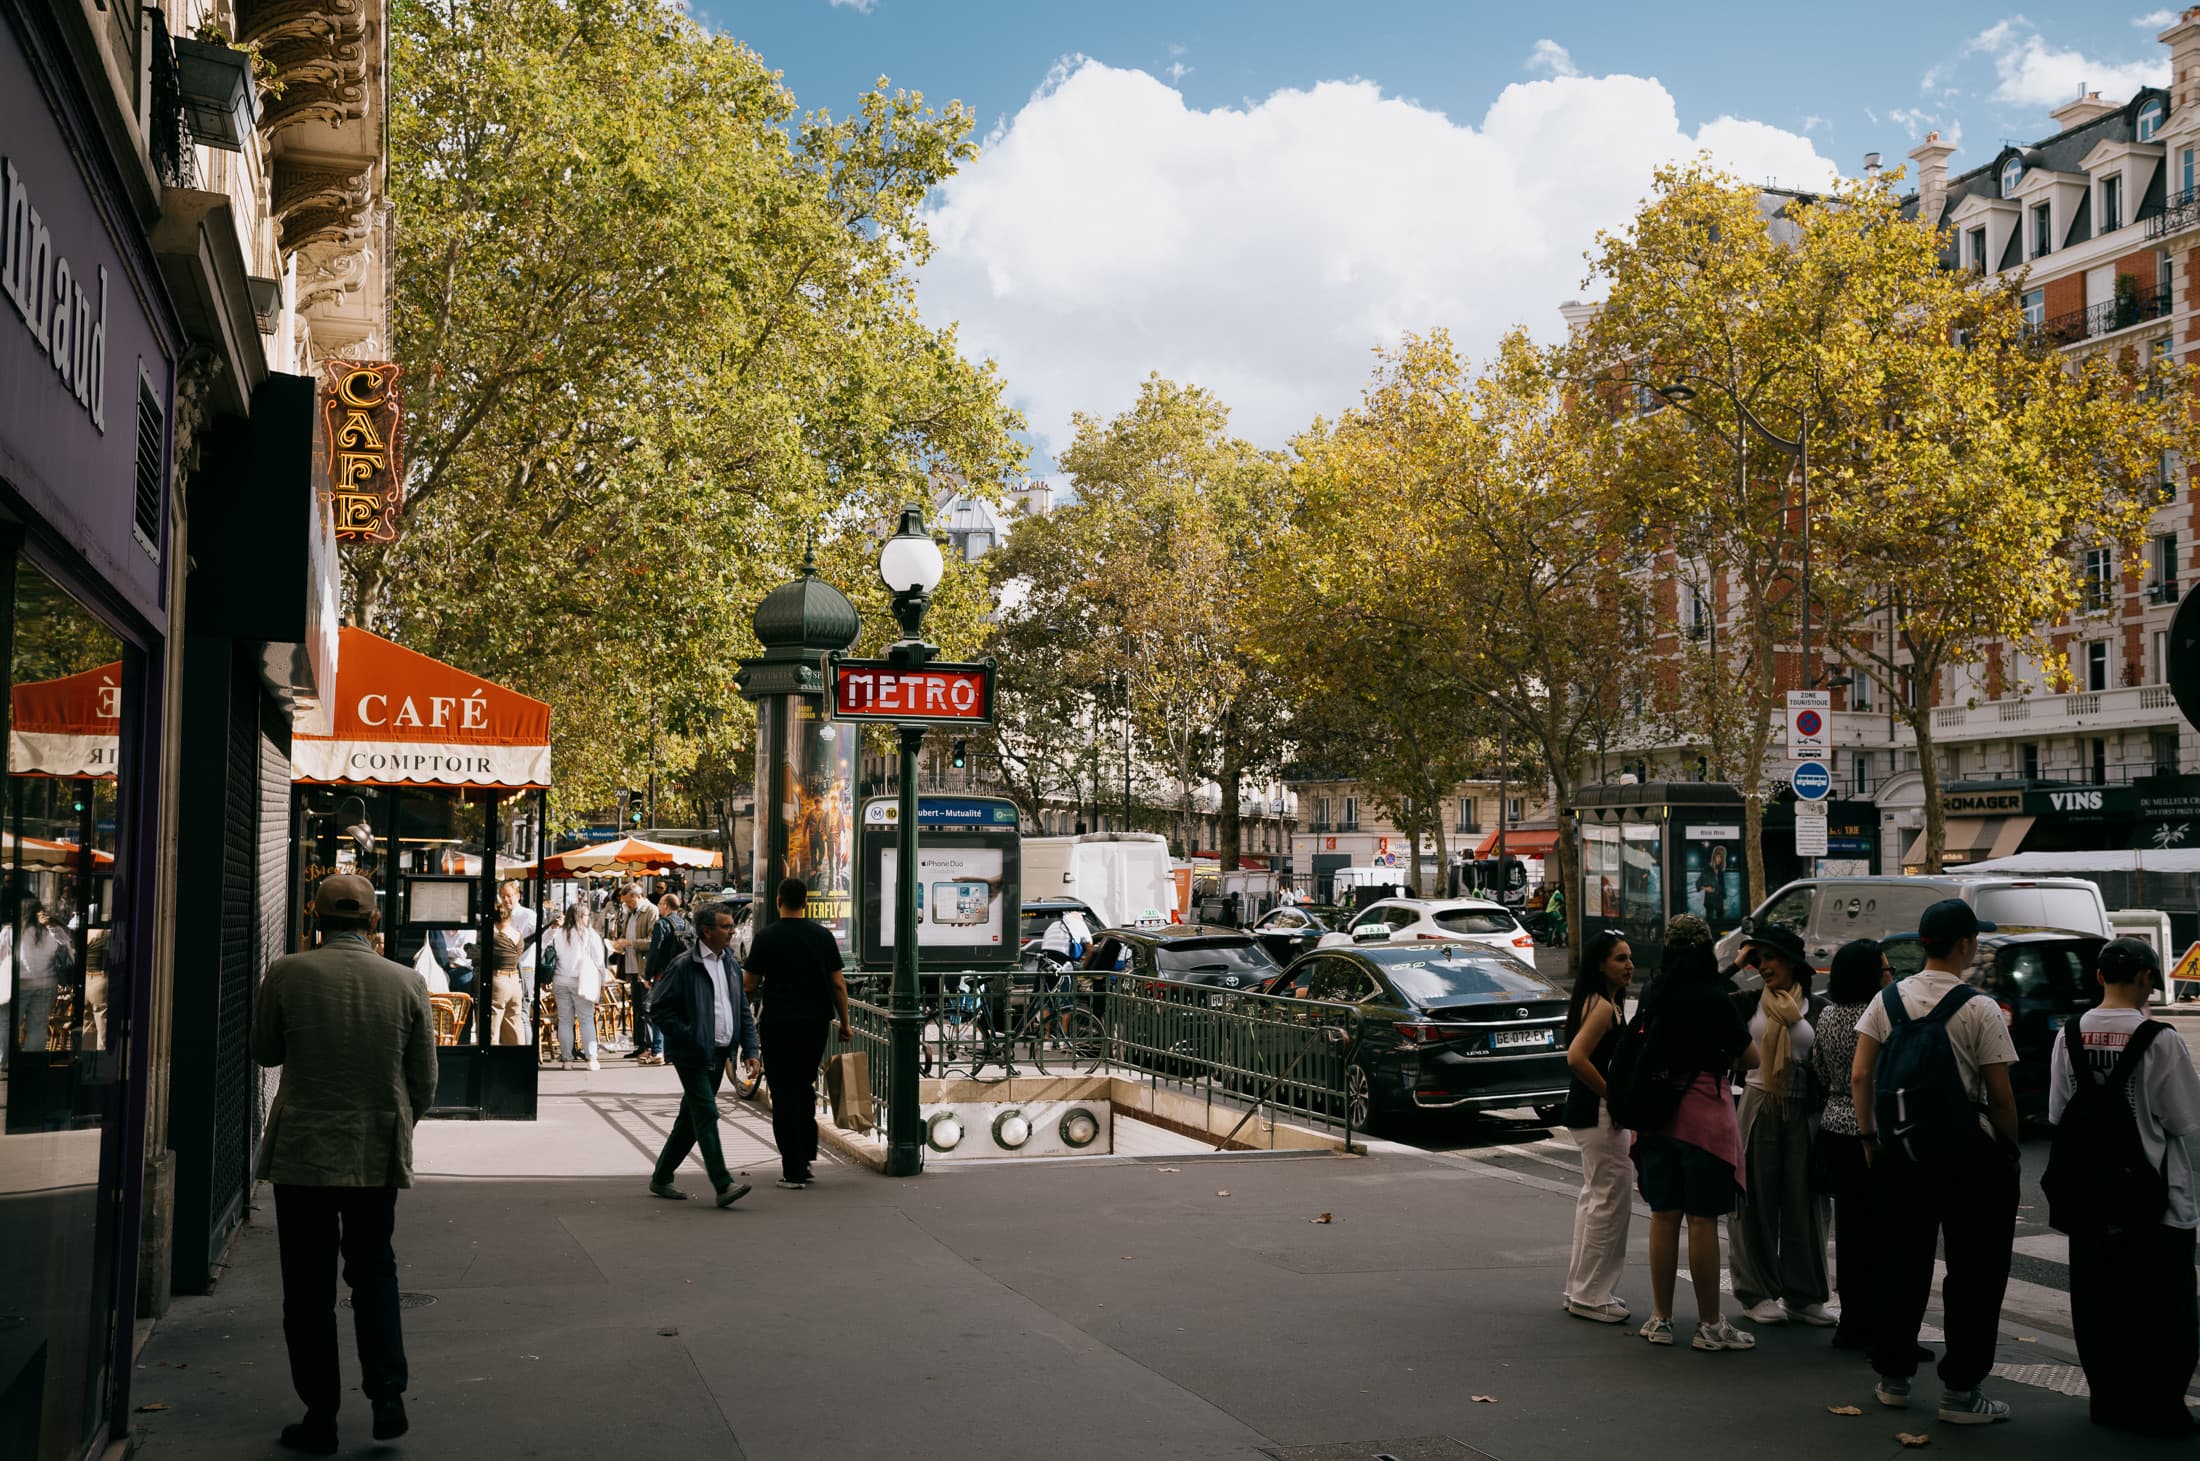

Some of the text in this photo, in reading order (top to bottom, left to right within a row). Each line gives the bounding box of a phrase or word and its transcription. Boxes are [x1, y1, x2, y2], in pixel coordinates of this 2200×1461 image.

[0, 158, 108, 433] nnaud
[336, 368, 385, 532] CAFE
[848, 674, 976, 711] METRO
[357, 687, 488, 729] CAFÉ
[351, 753, 491, 773] COMPTOIR
[886, 809, 897, 818] 10
[918, 809, 939, 818] ubert
[945, 809, 982, 818] Mutualité
[2050, 791, 2104, 811] VINS
